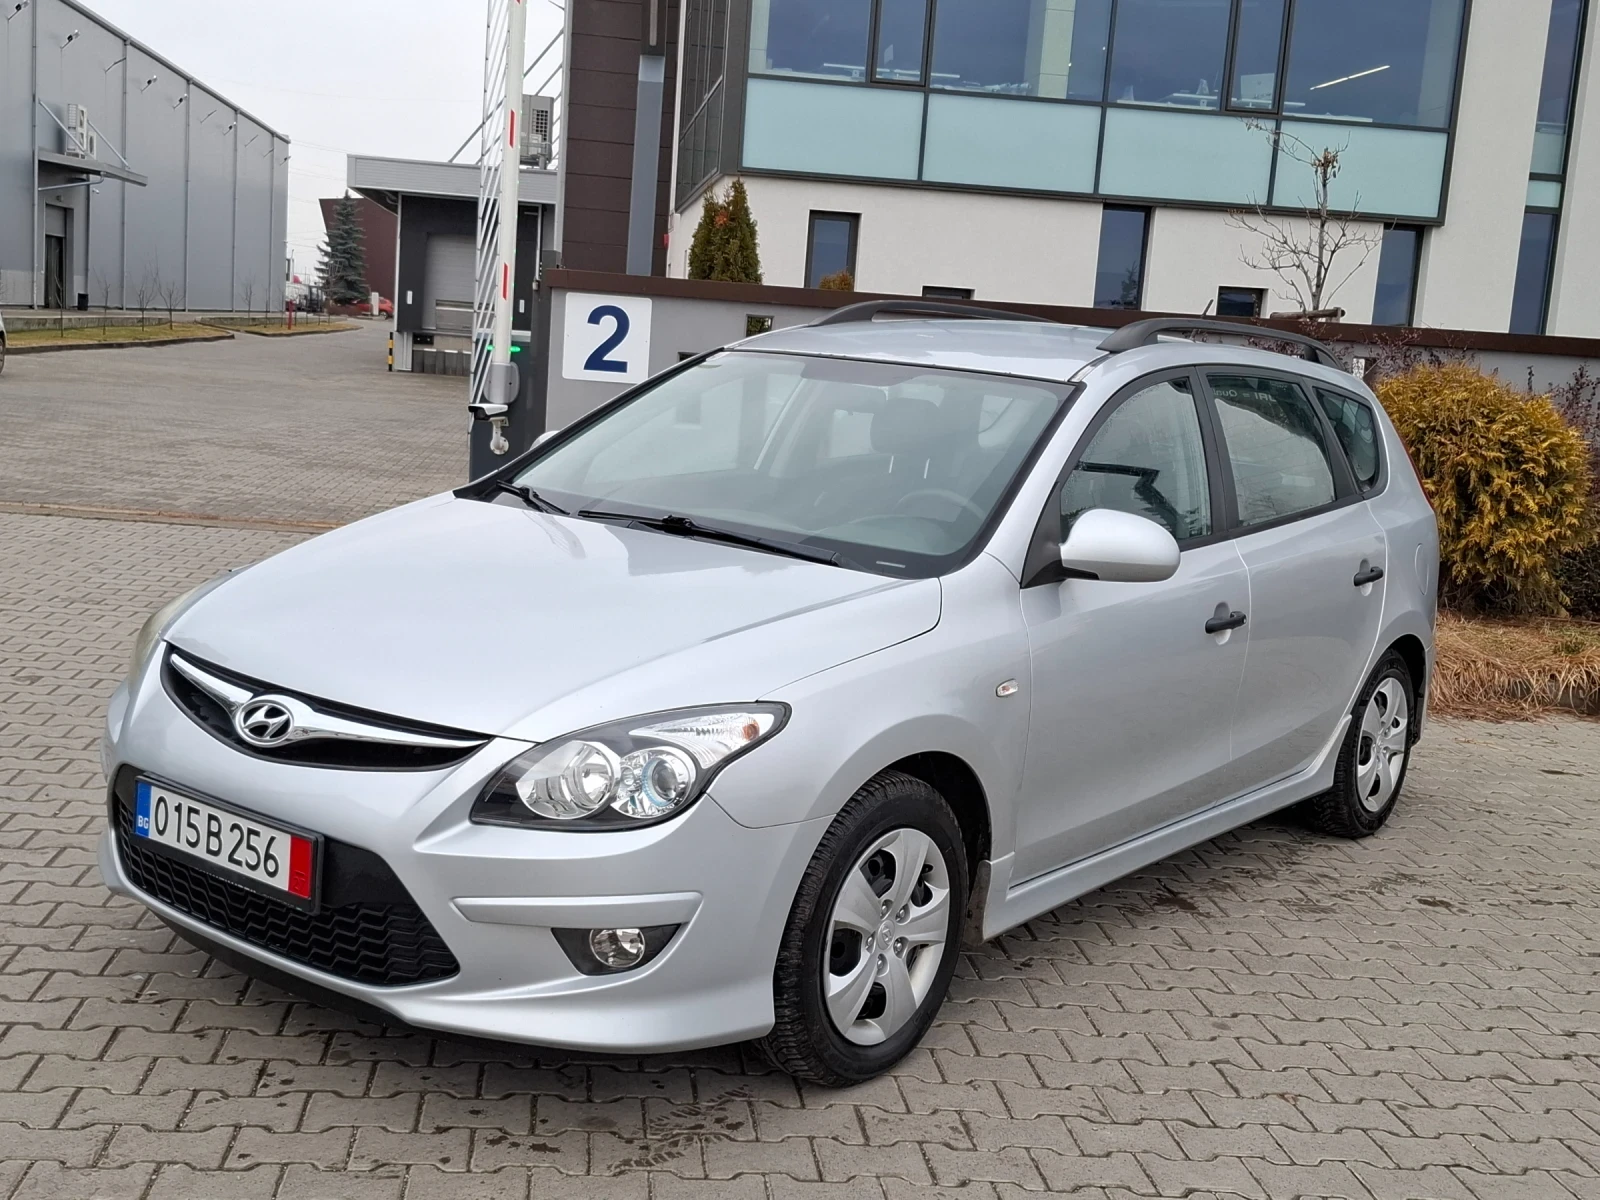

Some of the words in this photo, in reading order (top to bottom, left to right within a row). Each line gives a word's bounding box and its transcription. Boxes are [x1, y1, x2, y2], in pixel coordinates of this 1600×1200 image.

[583, 304, 630, 374] 2
[137, 815, 149, 829] BG
[154, 795, 280, 879] 015B256
